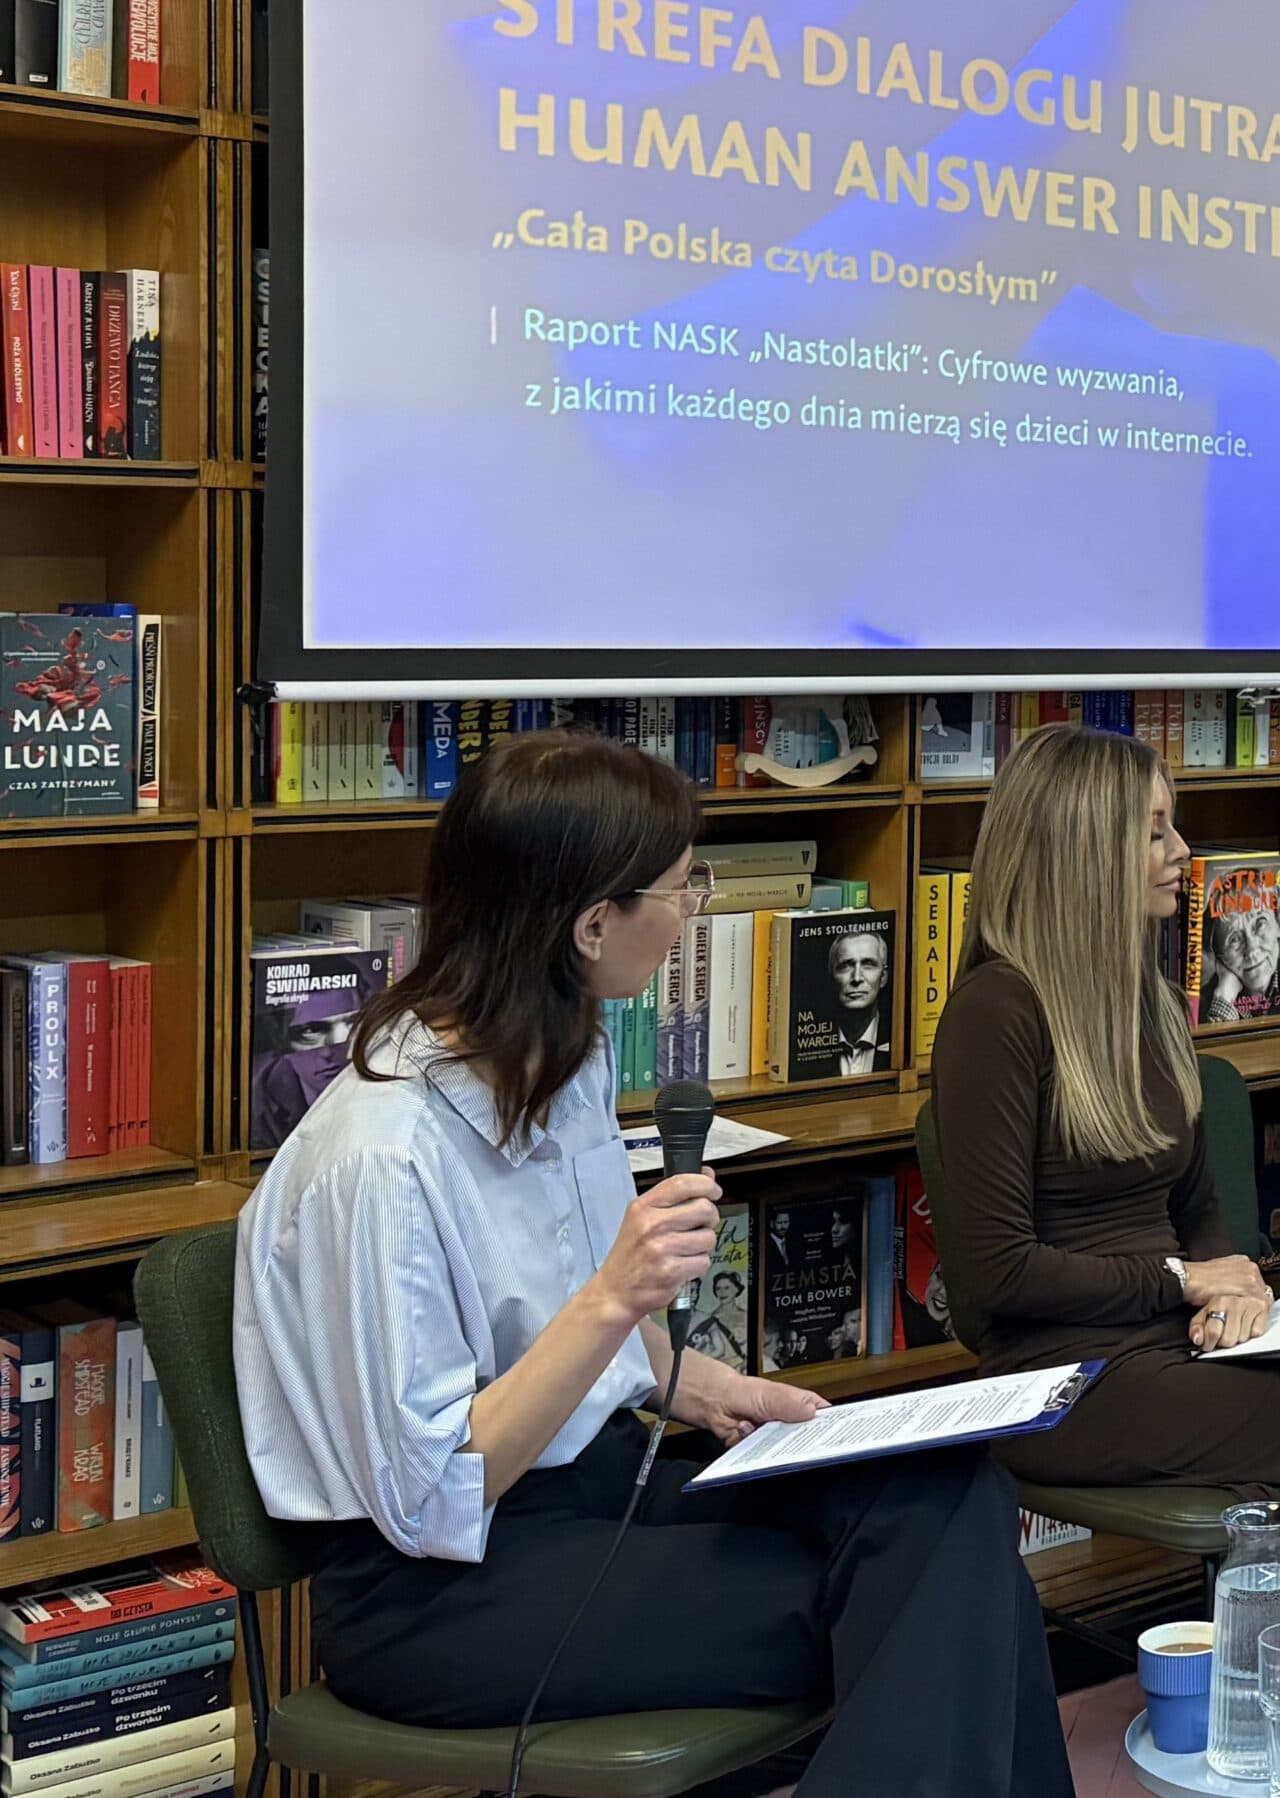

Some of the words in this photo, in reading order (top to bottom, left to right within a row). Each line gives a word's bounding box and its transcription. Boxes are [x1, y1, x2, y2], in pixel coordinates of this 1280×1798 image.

[494, 0, 780, 80] STREFA
[804, 30, 1102, 134] DIALOGU
[499, 90, 812, 192] HUMAN
[835, 142, 1120, 235] ANSWER
[492, 209, 609, 255] „Cała
[623, 221, 753, 269] Polska
[763, 243, 860, 284] czyta
[870, 248, 1057, 306] Dorosłym”
[107, 304, 122, 360] DRZEWO
[523, 308, 641, 351] Raport
[653, 321, 739, 357] NASK
[747, 331, 929, 375] „Nastolatki”:
[938, 348, 1048, 385] Cyfrowe
[1056, 366, 1185, 400] wyzwania,
[525, 383, 542, 406] z
[549, 376, 657, 415] jakimi
[667, 383, 791, 430] każdego
[800, 395, 862, 430] dnia
[870, 404, 961, 444] mierzą
[969, 410, 1007, 447] się
[1015, 413, 1089, 446] dzieci
[1097, 425, 1119, 447] w
[1126, 421, 1254, 458] internecie.
[12, 708, 113, 733] MAJA
[431, 702, 451, 758] MEDA
[1151, 702, 1166, 741] Pola
[1168, 702, 1183, 742] Pola
[1270, 702, 1280, 732] ISTY
[4, 743, 121, 769] LUNDE
[9, 779, 38, 791] CZAS
[41, 779, 117, 790] ZATRZYMANY
[1211, 870, 1276, 895] ASTRID
[695, 925, 708, 963] ZGIEŁK
[799, 925, 823, 938] JENS
[825, 920, 889, 936] STOLTENBERG
[926, 883, 939, 1004] SEBALD
[668, 934, 681, 966] IEŁK
[266, 963, 310, 980] KONRAD
[266, 973, 358, 995] SWINARSKI
[668, 967, 681, 1005] SERCA
[695, 965, 707, 1002] SERCA
[44, 983, 60, 1081] PROULX
[797, 1011, 814, 1023] NA
[797, 1021, 833, 1036] MOJEJ
[797, 1033, 838, 1049] WARCIE
[771, 1262, 857, 1293] ZEMSTA
[775, 1293, 803, 1309] TOM
[806, 1285, 853, 1303] BOWER
[95, 1630, 119, 1644] MOJE
[110, 1688, 159, 1706] dzwonku
[111, 1687, 126, 1697] Po
[127, 1677, 167, 1694] trzecim
[114, 1713, 163, 1733] dzwonku
[115, 1713, 130, 1724] Po
[131, 1703, 171, 1719] trzecim
